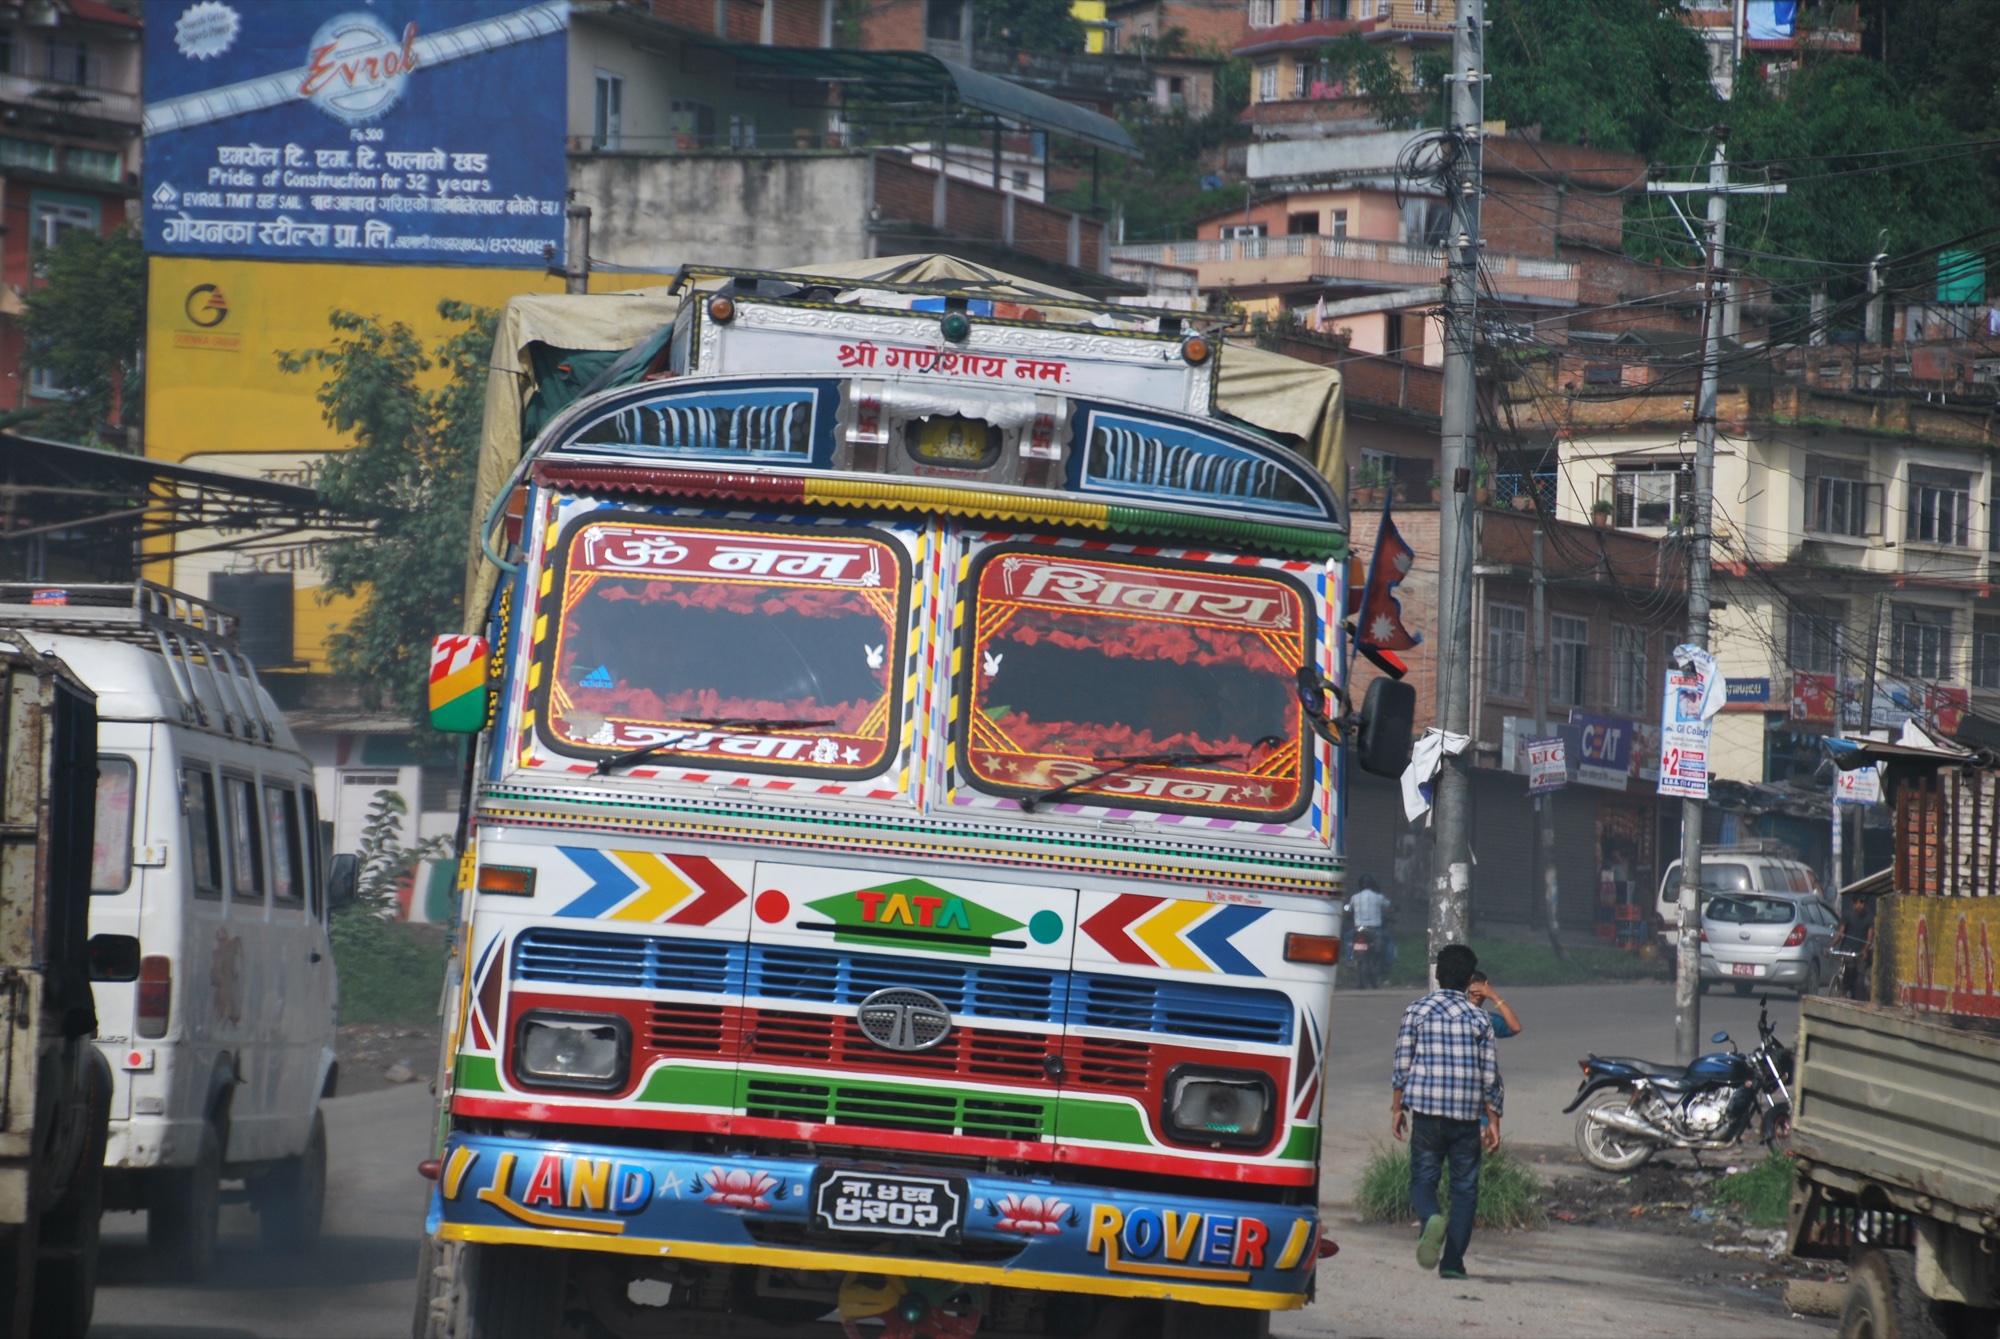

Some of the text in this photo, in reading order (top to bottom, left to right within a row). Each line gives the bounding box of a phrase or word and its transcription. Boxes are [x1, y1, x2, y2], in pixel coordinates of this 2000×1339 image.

[300, 21, 419, 96] Evrol
[365, 127, 384, 142] 500
[208, 167, 492, 196] Pride of Construction for 32 years
[183, 192, 224, 208] EVROL
[225, 193, 252, 208] TMT
[279, 194, 302, 209] SAIL
[162, 211, 256, 244] गोयनका
[258, 215, 329, 247] स्टील्स
[837, 340, 1071, 384] श्री गणेशाय नमः
[709, 546, 861, 578] नम
[1022, 566, 1279, 622] शिवाय
[580, 679, 614, 689] adidas
[1582, 724, 1621, 762] CEAT
[1687, 726, 1709, 739] College
[1531, 748, 1565, 766] EIC
[1663, 747, 1679, 776] +2
[1532, 773, 1545, 786] +2
[1839, 775, 1855, 790] +2
[856, 891, 971, 930] TATA
[877, 1185, 899, 1201] ४
[477, 1152, 1270, 1283] LAND ROVER
[835, 1197, 939, 1228] ४३०२
